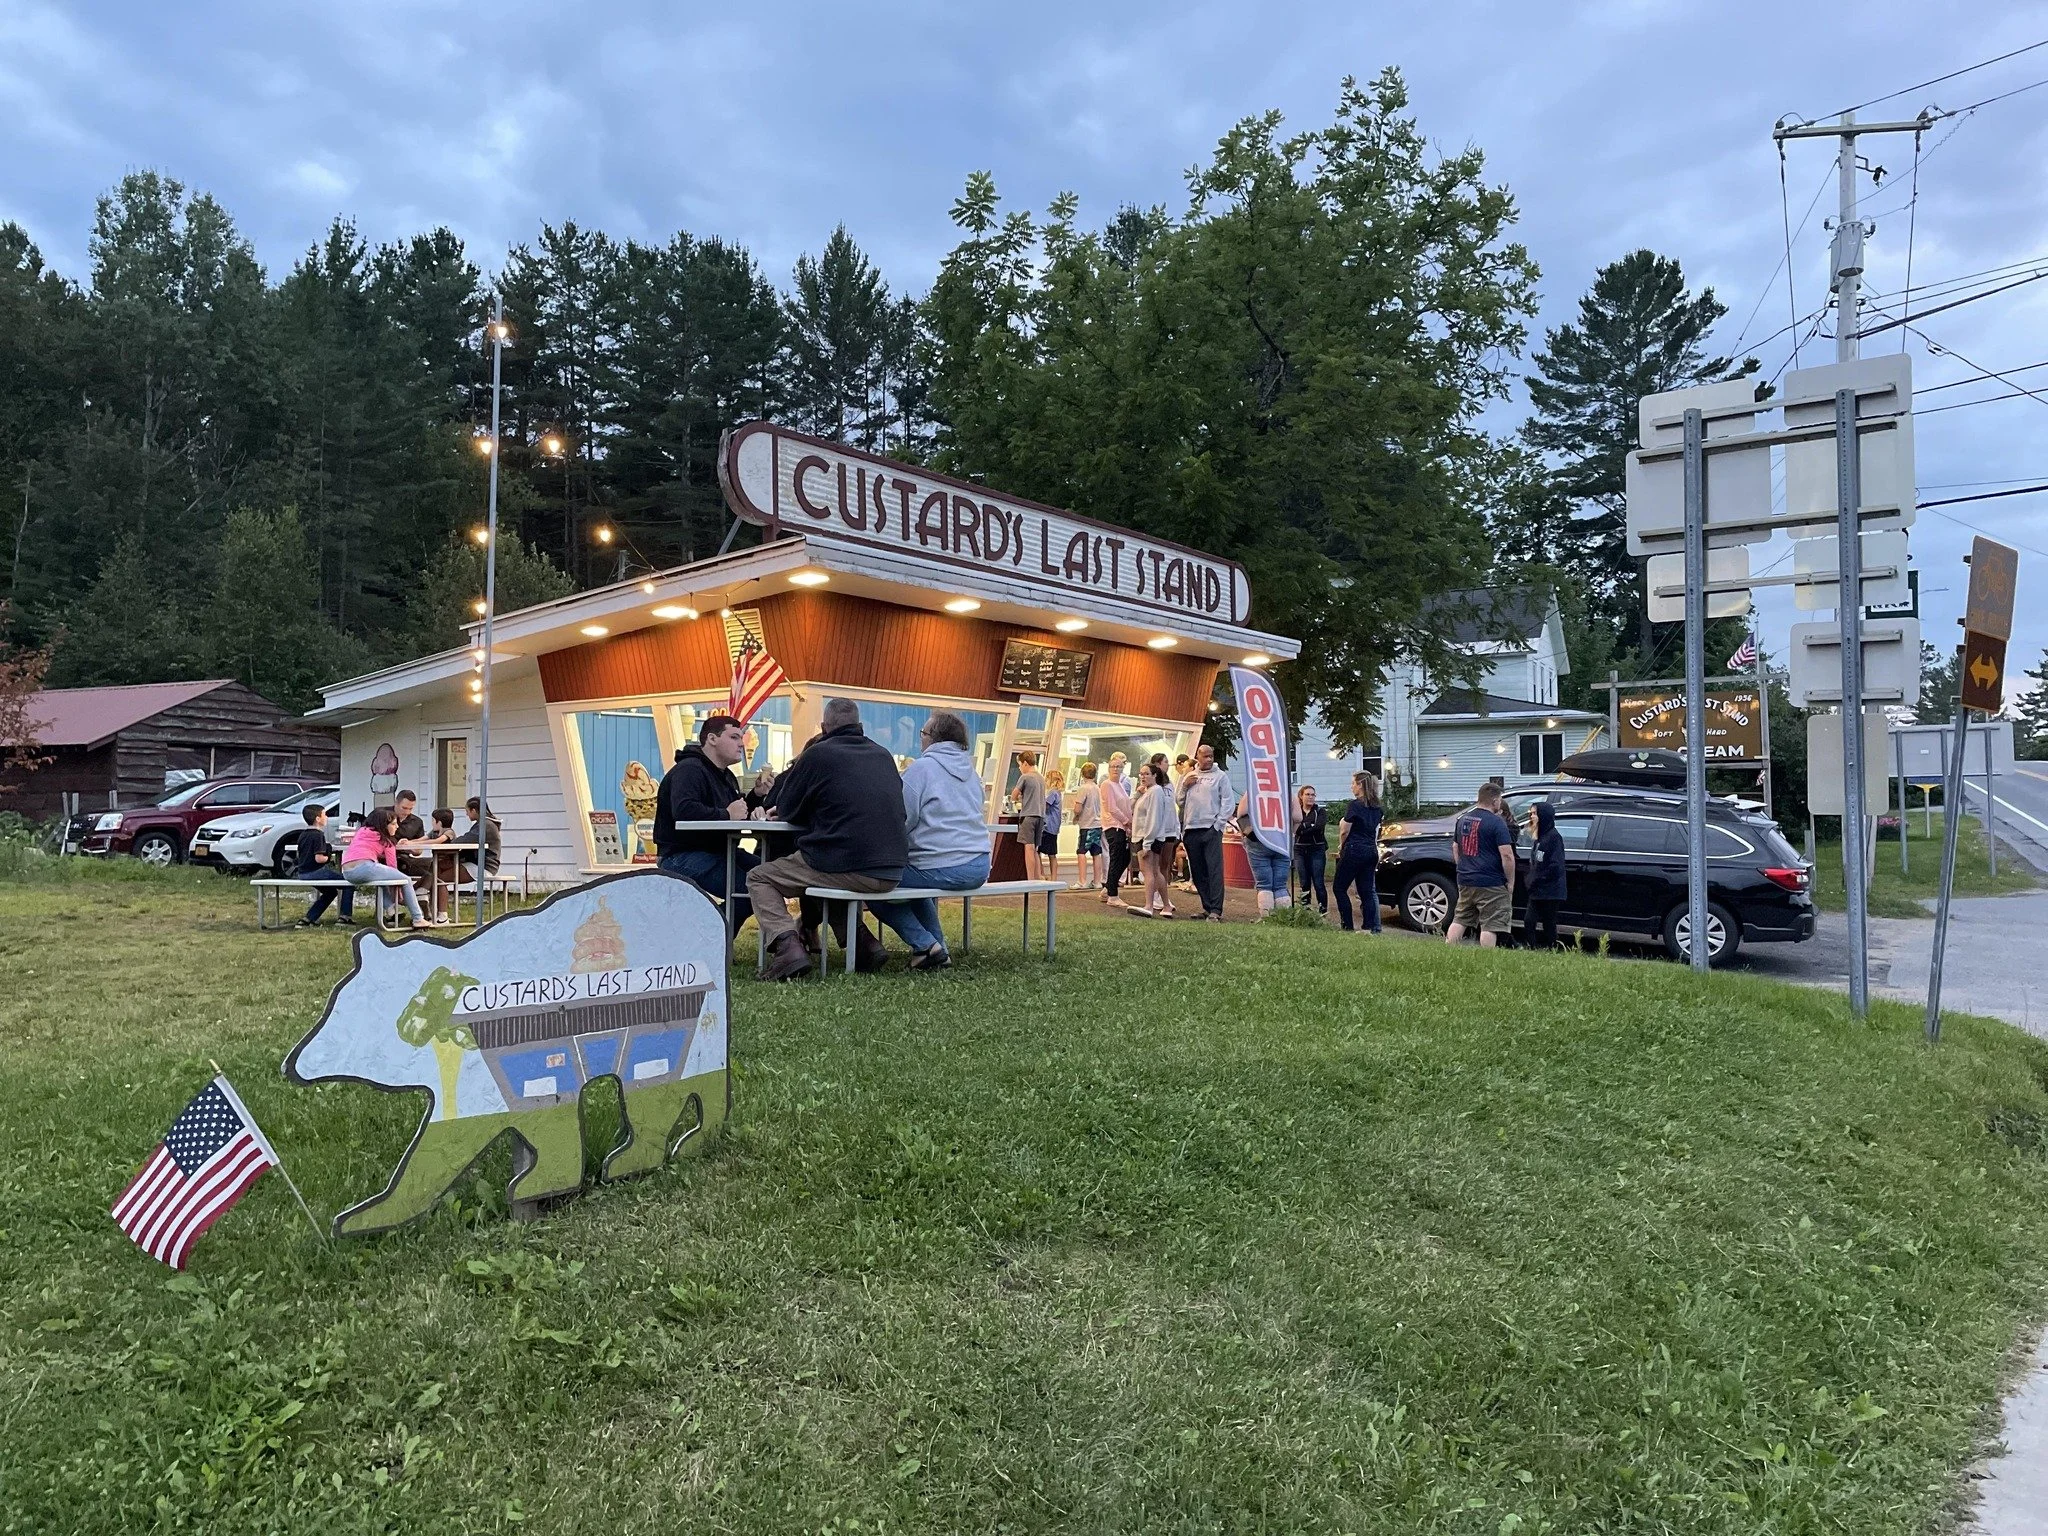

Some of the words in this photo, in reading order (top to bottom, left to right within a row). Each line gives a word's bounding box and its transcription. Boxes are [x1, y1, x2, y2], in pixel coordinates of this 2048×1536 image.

[793, 455, 1023, 566] CUSTARD'S
[1041, 519, 1125, 589] LAST
[1136, 548, 1221, 613] STAND
[1704, 698, 1720, 710] ST
[1720, 700, 1749, 726] STAND
[463, 975, 577, 1012] CUSTARD'S
[587, 969, 633, 998] LAST
[643, 962, 697, 992] STAND
